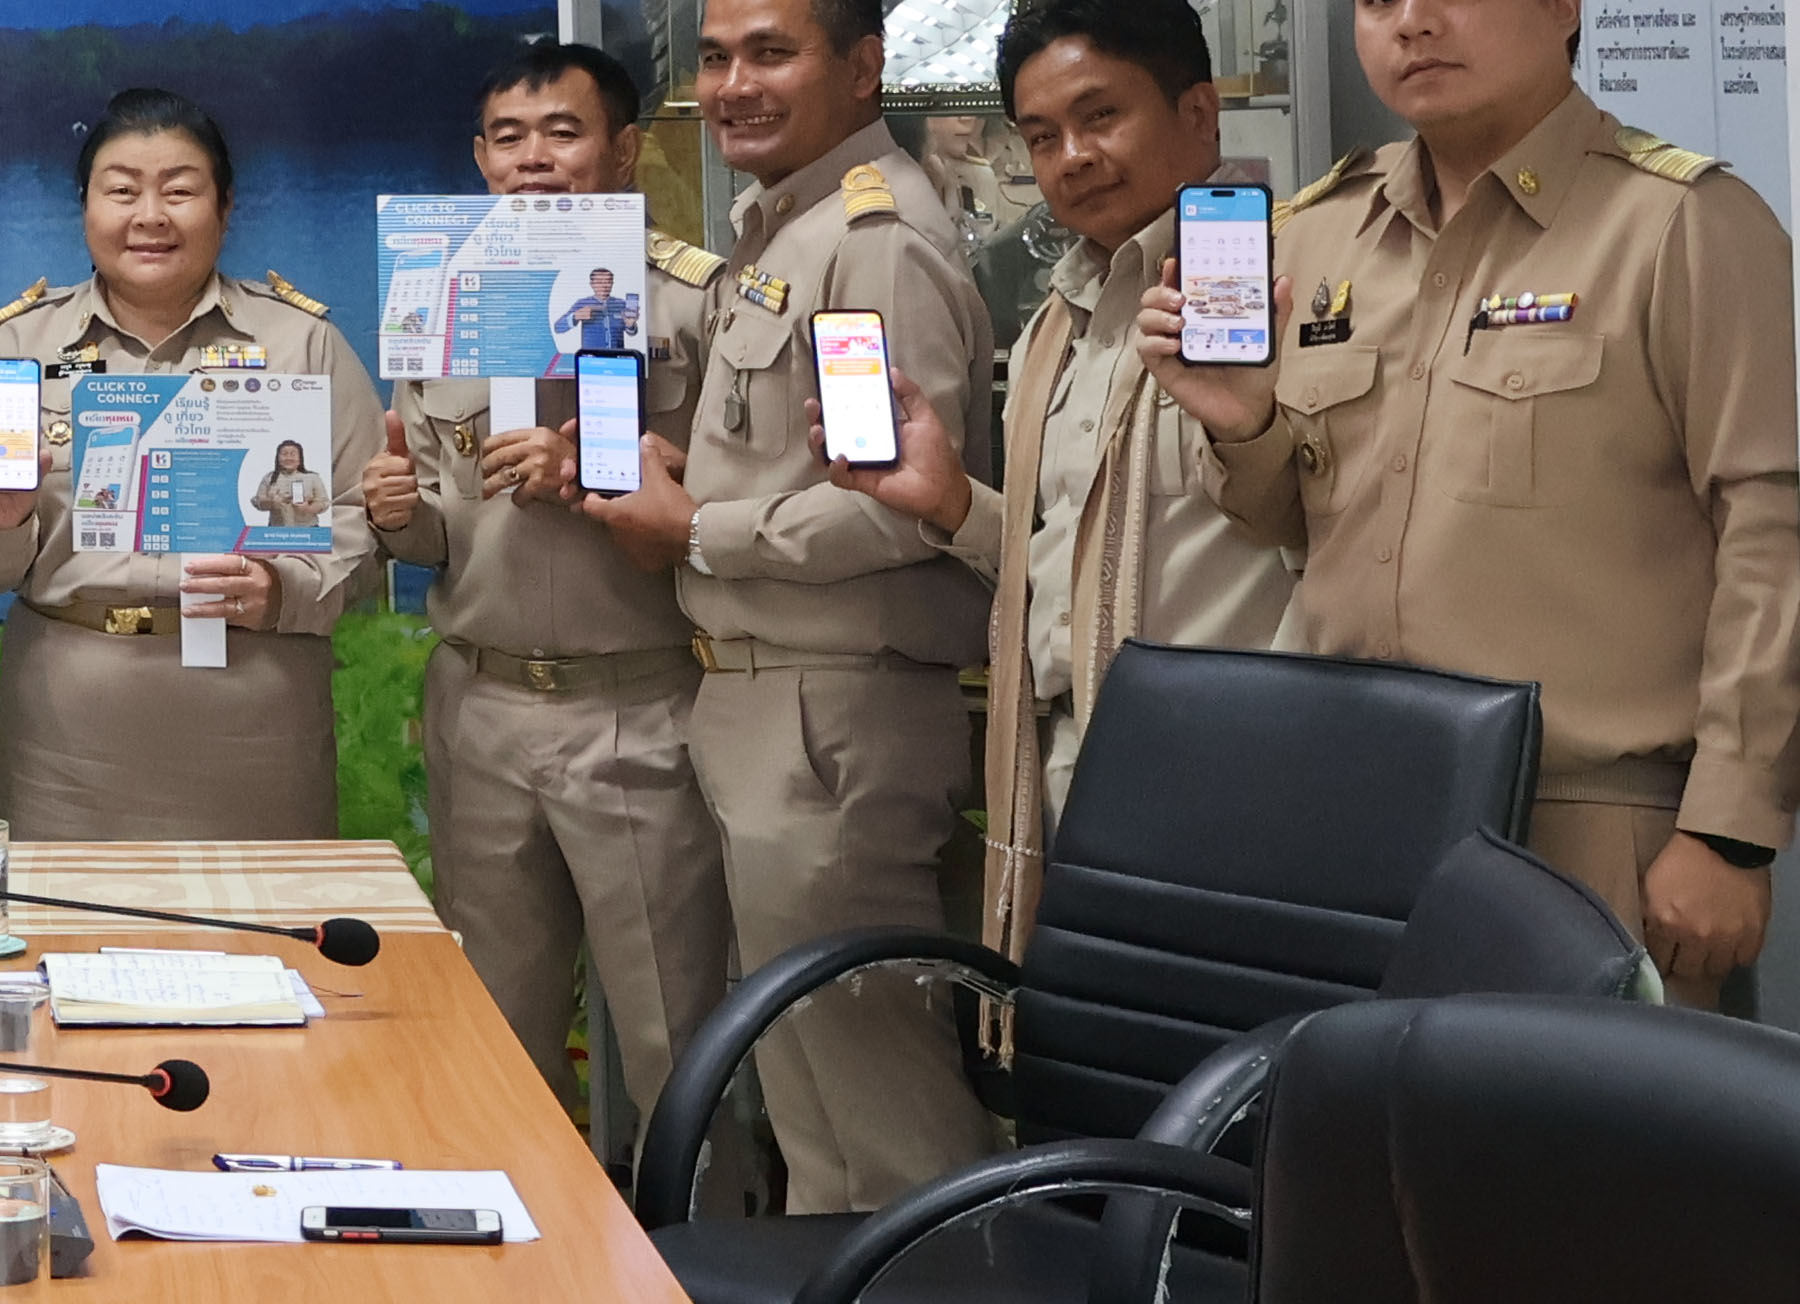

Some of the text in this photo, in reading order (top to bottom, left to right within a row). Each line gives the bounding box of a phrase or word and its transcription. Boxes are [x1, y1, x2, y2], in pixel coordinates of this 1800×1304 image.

[87, 381, 146, 392] CLICK TO
[97, 393, 160, 405] CONNECT
